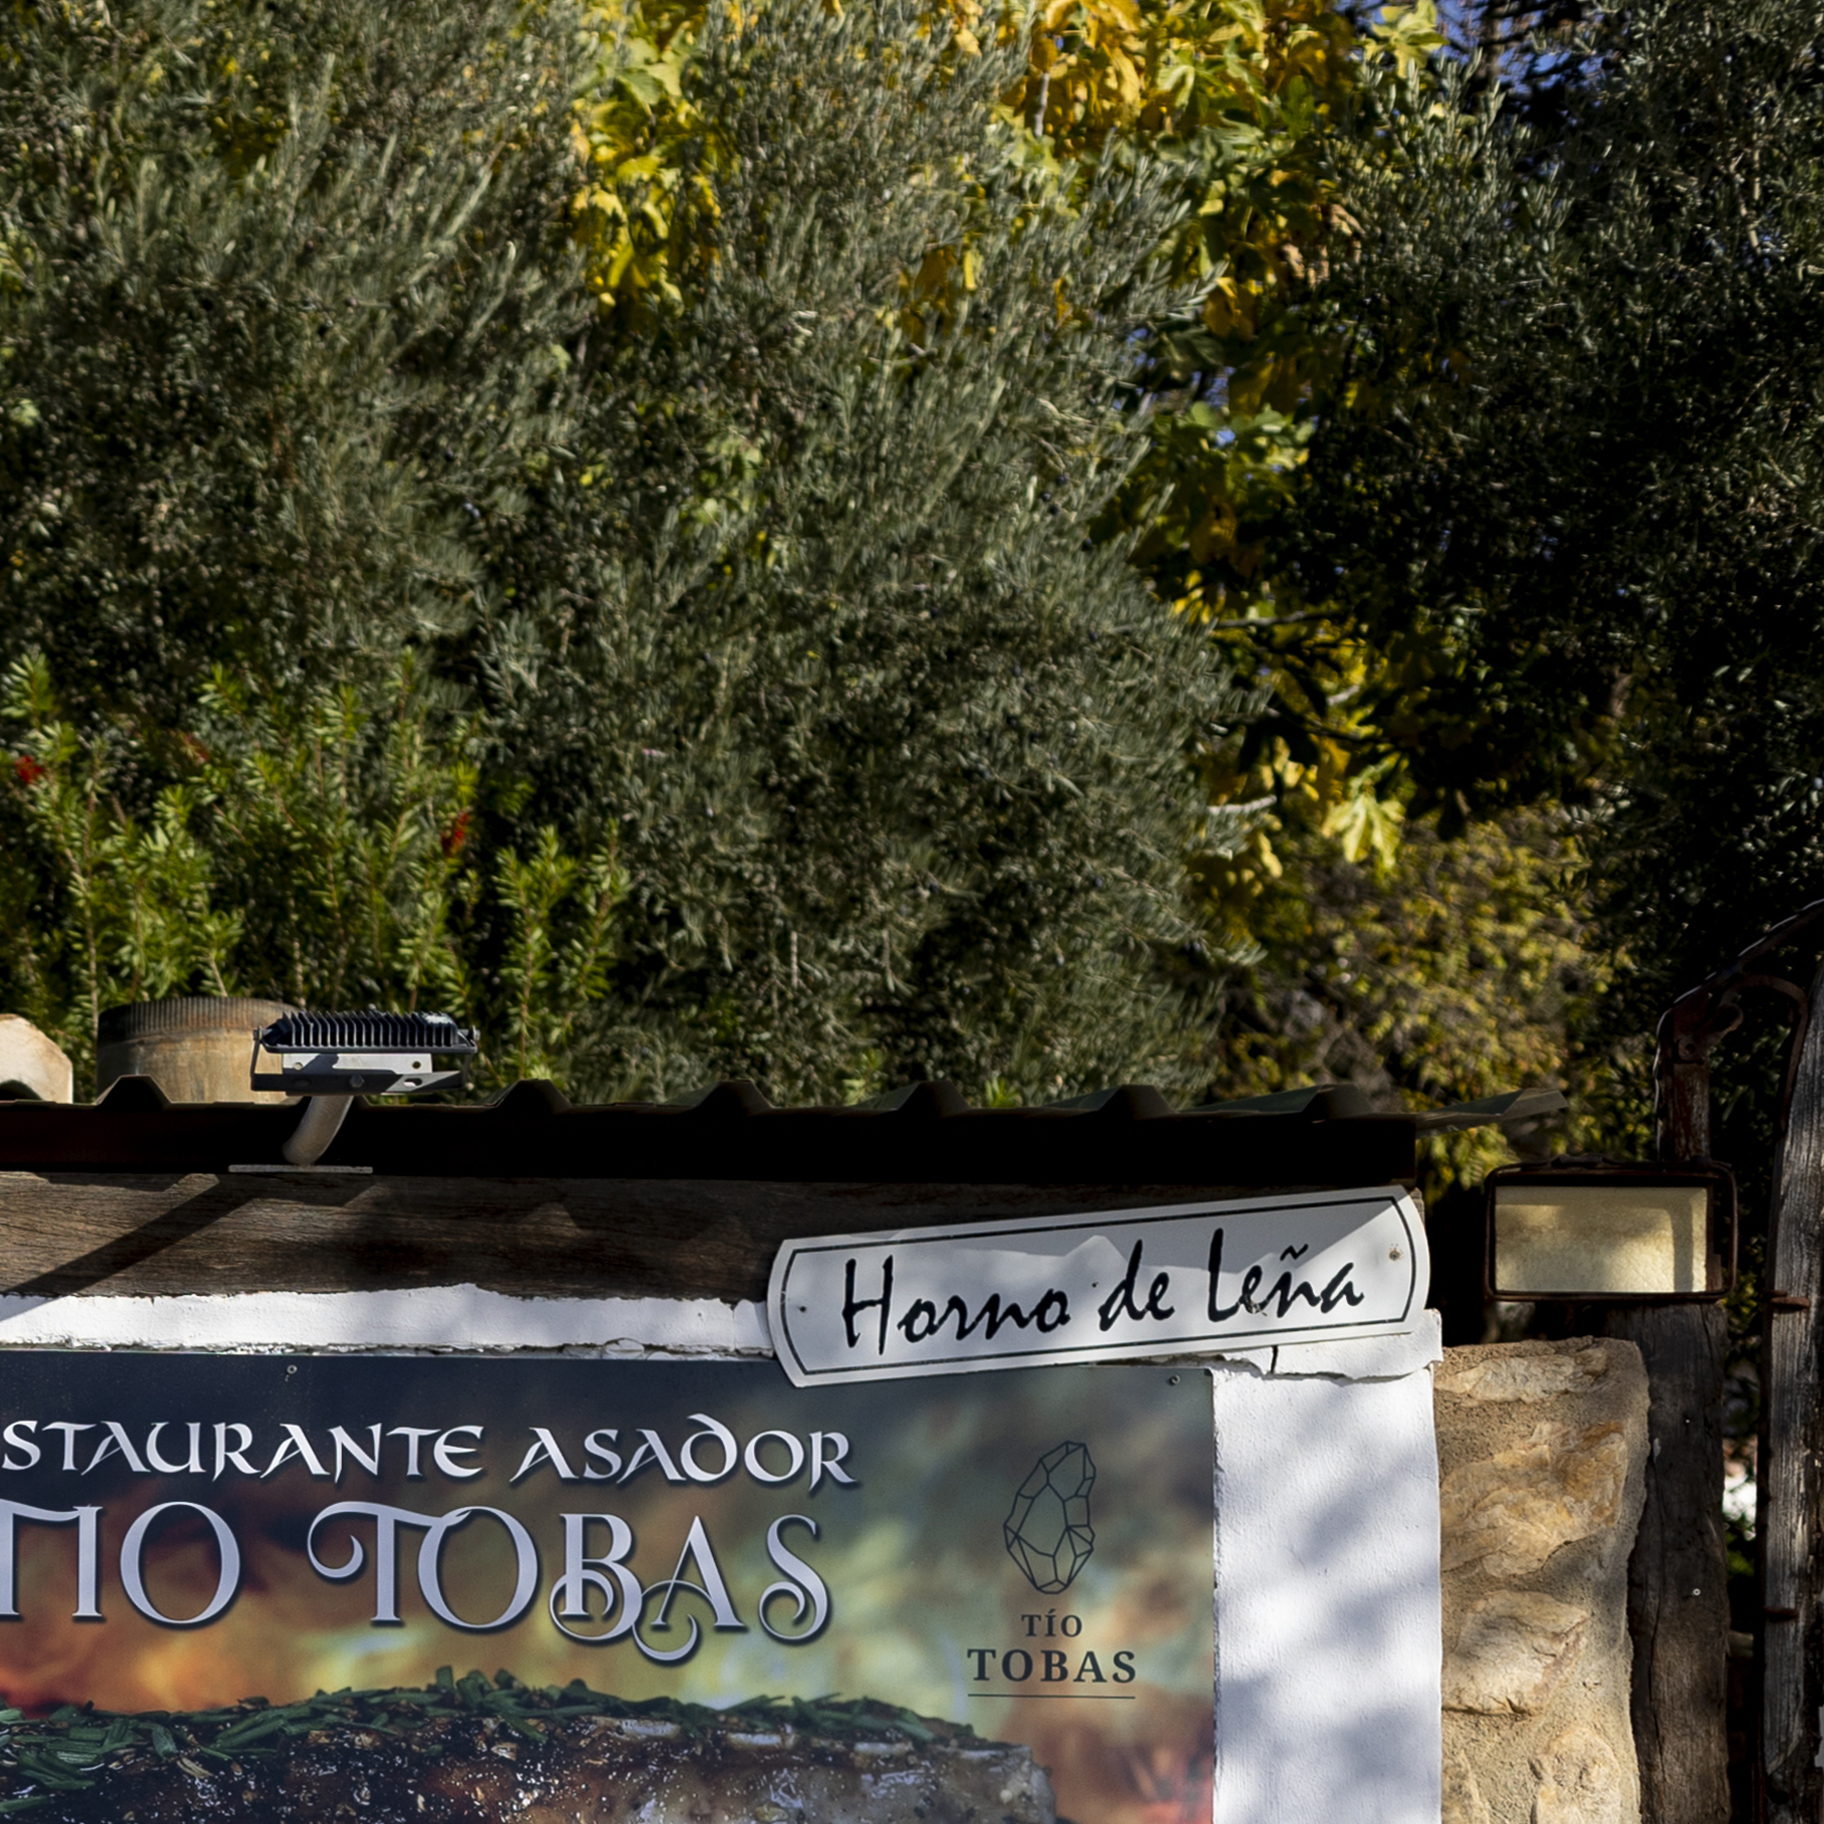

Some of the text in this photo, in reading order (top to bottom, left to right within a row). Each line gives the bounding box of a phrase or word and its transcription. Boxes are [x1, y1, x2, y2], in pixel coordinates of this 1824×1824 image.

[840, 1228, 1365, 1356] Horno de Leña
[509, 1413, 859, 1491] ASADOR
[307, 1501, 829, 1662] TOBAS
[1021, 1608, 1083, 1637] TÍO
[967, 1648, 1136, 1684] TOBAS
